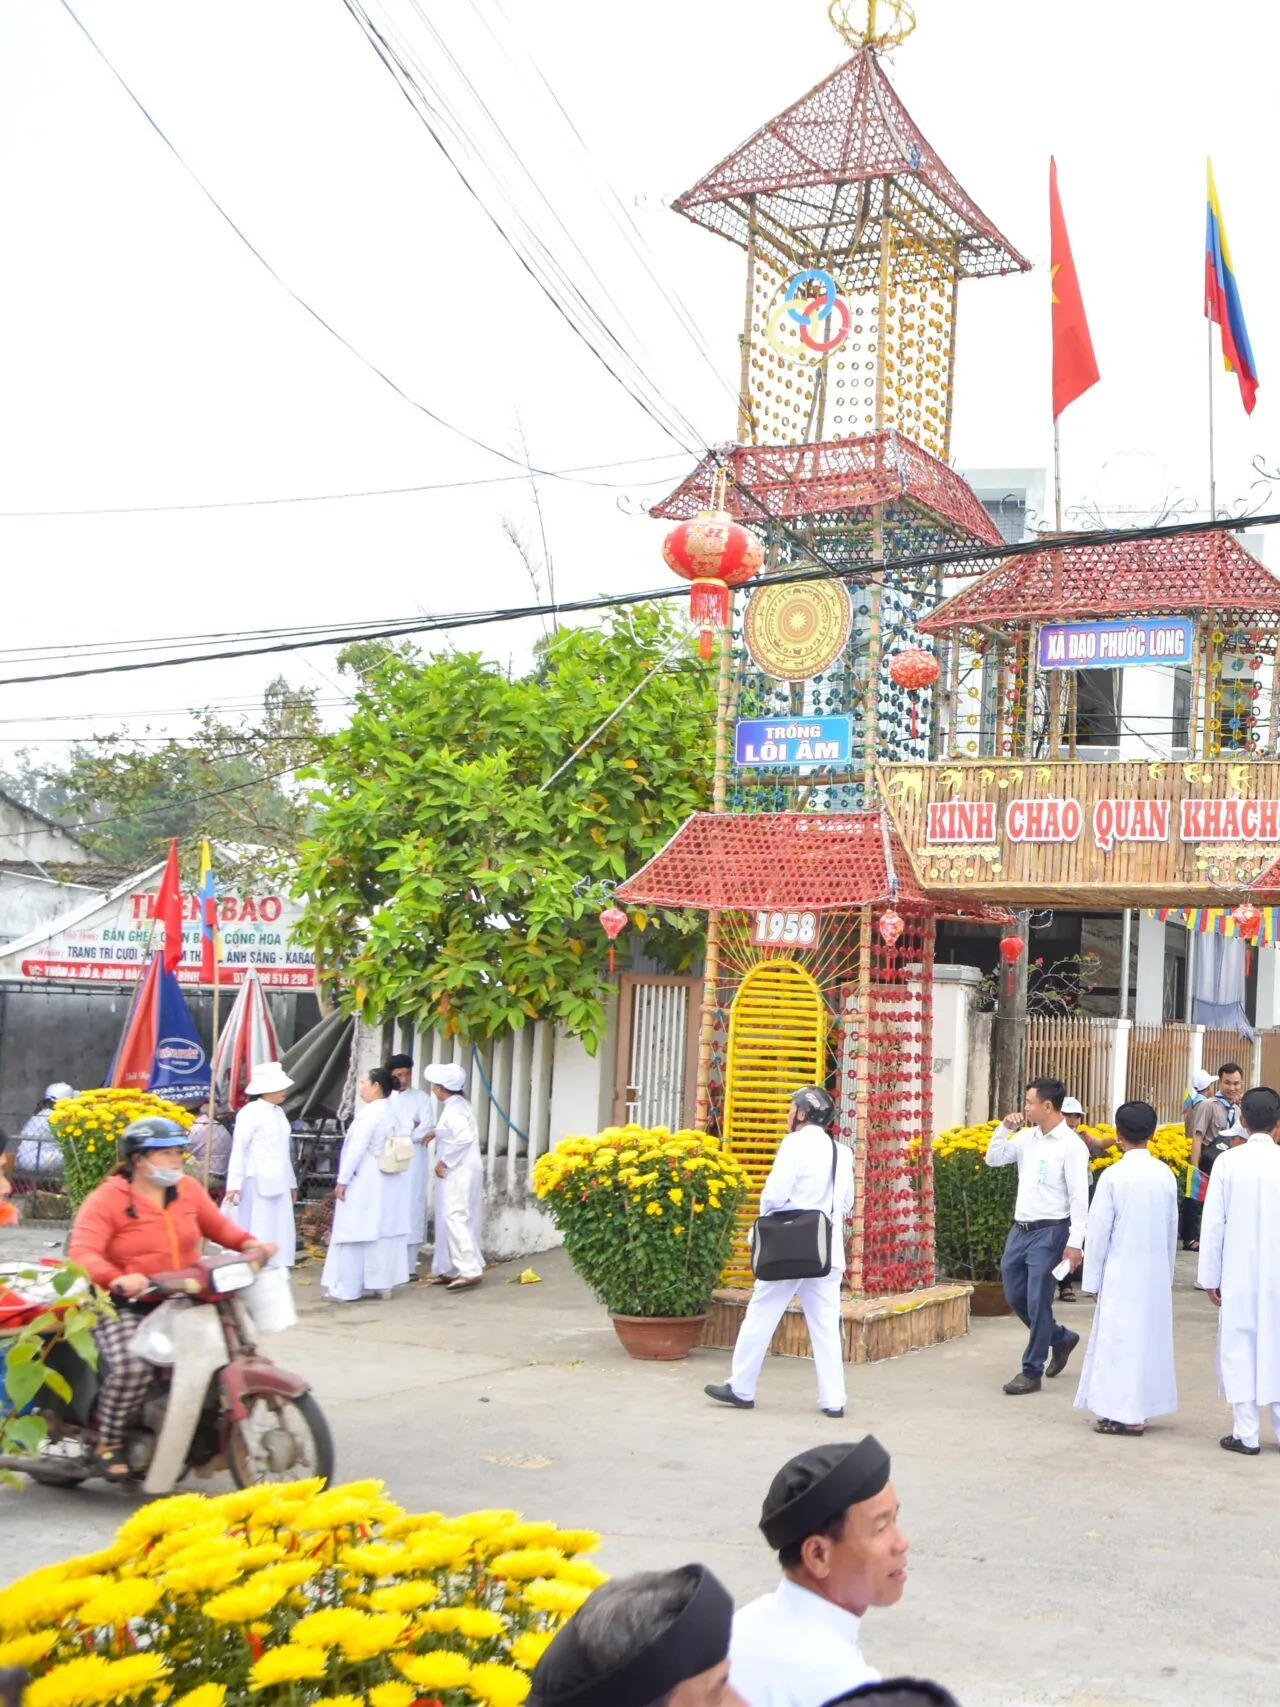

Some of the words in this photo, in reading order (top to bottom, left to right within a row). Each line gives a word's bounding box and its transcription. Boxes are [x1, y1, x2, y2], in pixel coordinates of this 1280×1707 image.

[1068, 632, 1096, 663] ĐẠO
[1099, 626, 1146, 658] PHƯỚC
[1149, 628, 1185, 656] LONG
[765, 722, 821, 739] TRỐNG
[745, 741, 787, 762] LÔI
[795, 740, 840, 760] ÂM
[928, 795, 996, 841] KÍNH
[1006, 793, 1081, 841] CHÀO
[1094, 799, 1170, 850] QUAN
[1181, 791, 1280, 841] KHÁCH
[756, 911, 816, 944] 1958
[259, 934, 281, 945] HOA
[68, 946, 96, 959] TRANG
